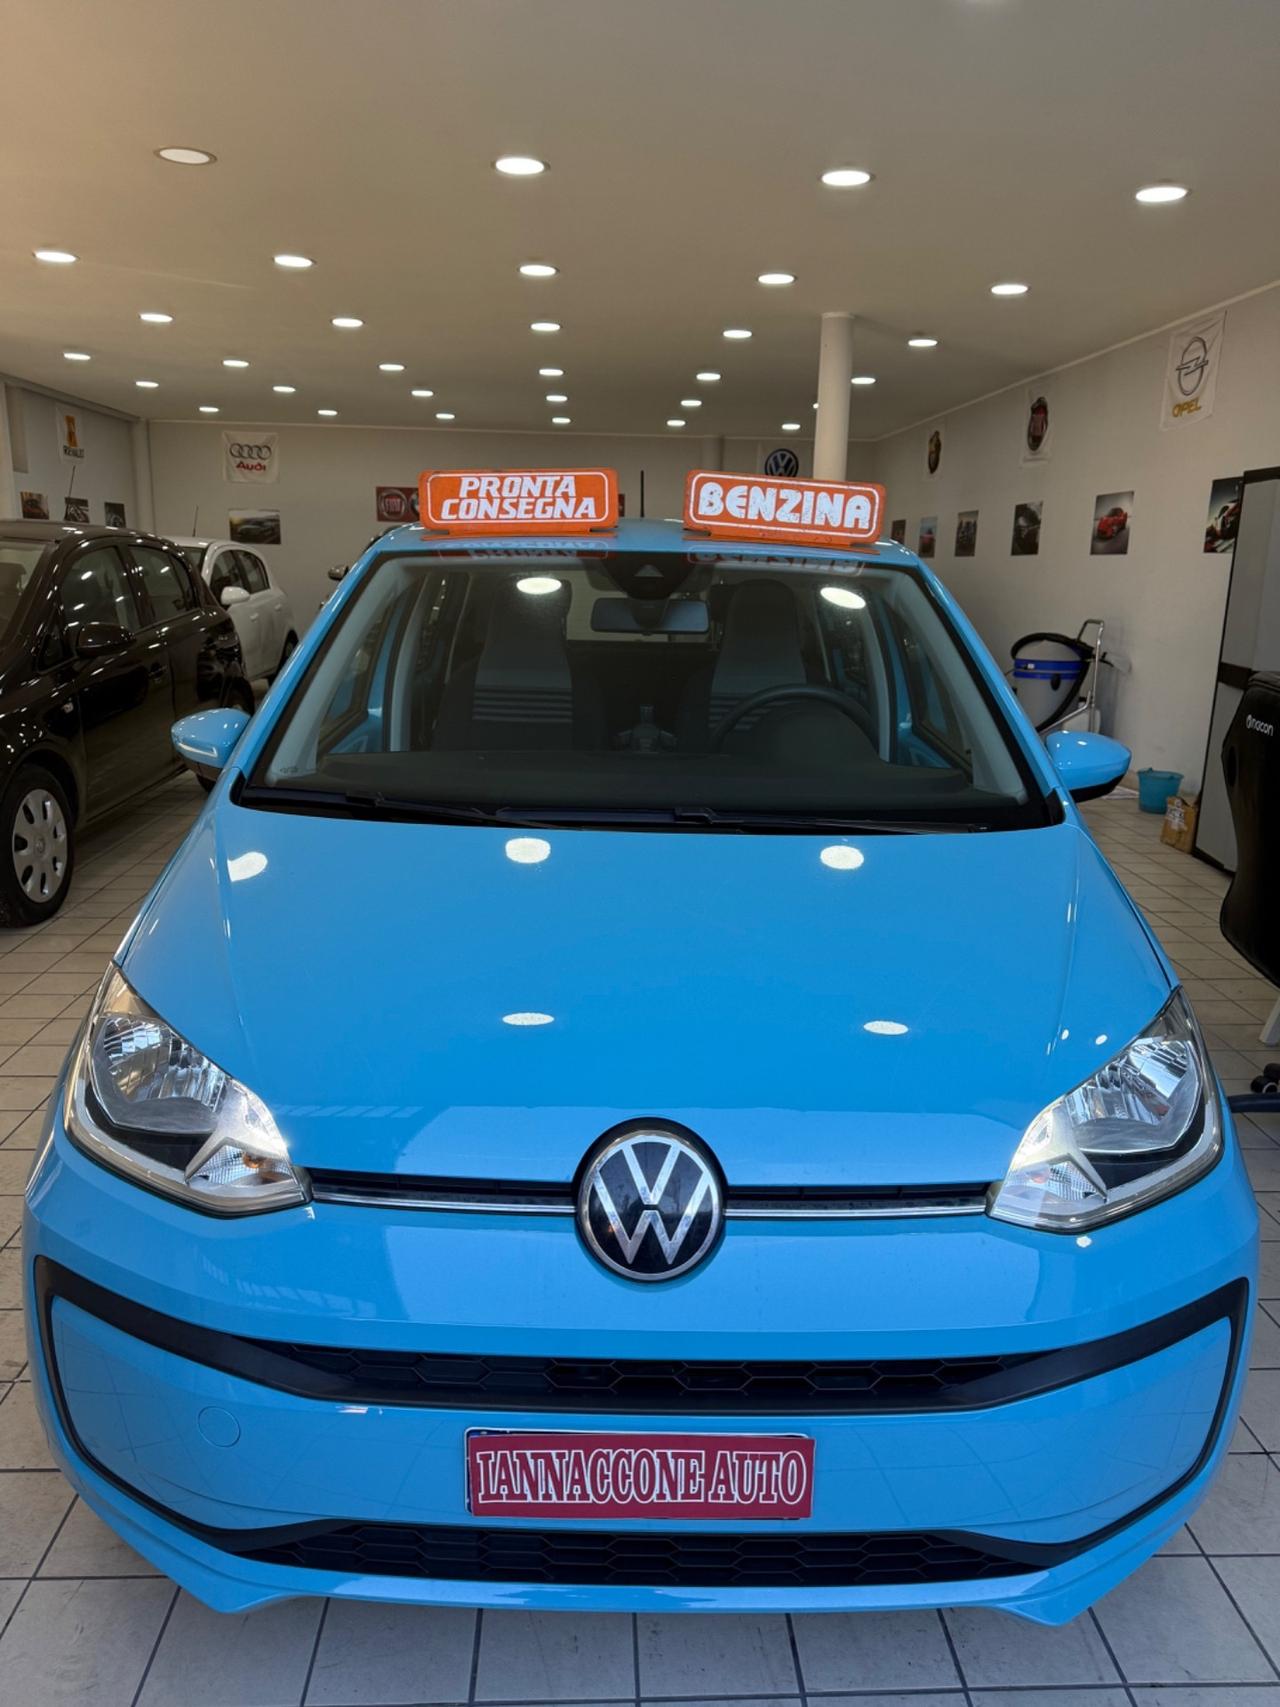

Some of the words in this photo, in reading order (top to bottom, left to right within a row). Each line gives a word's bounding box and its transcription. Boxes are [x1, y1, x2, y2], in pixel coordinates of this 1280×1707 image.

[1172, 397, 1202, 418] OPEL
[459, 475, 576, 498] PRONTA
[441, 497, 596, 519] CONSEGNA
[697, 481, 871, 530] BENZINA
[476, 1448, 706, 1505] IANNACCONE
[708, 1450, 807, 1505] AUTO
